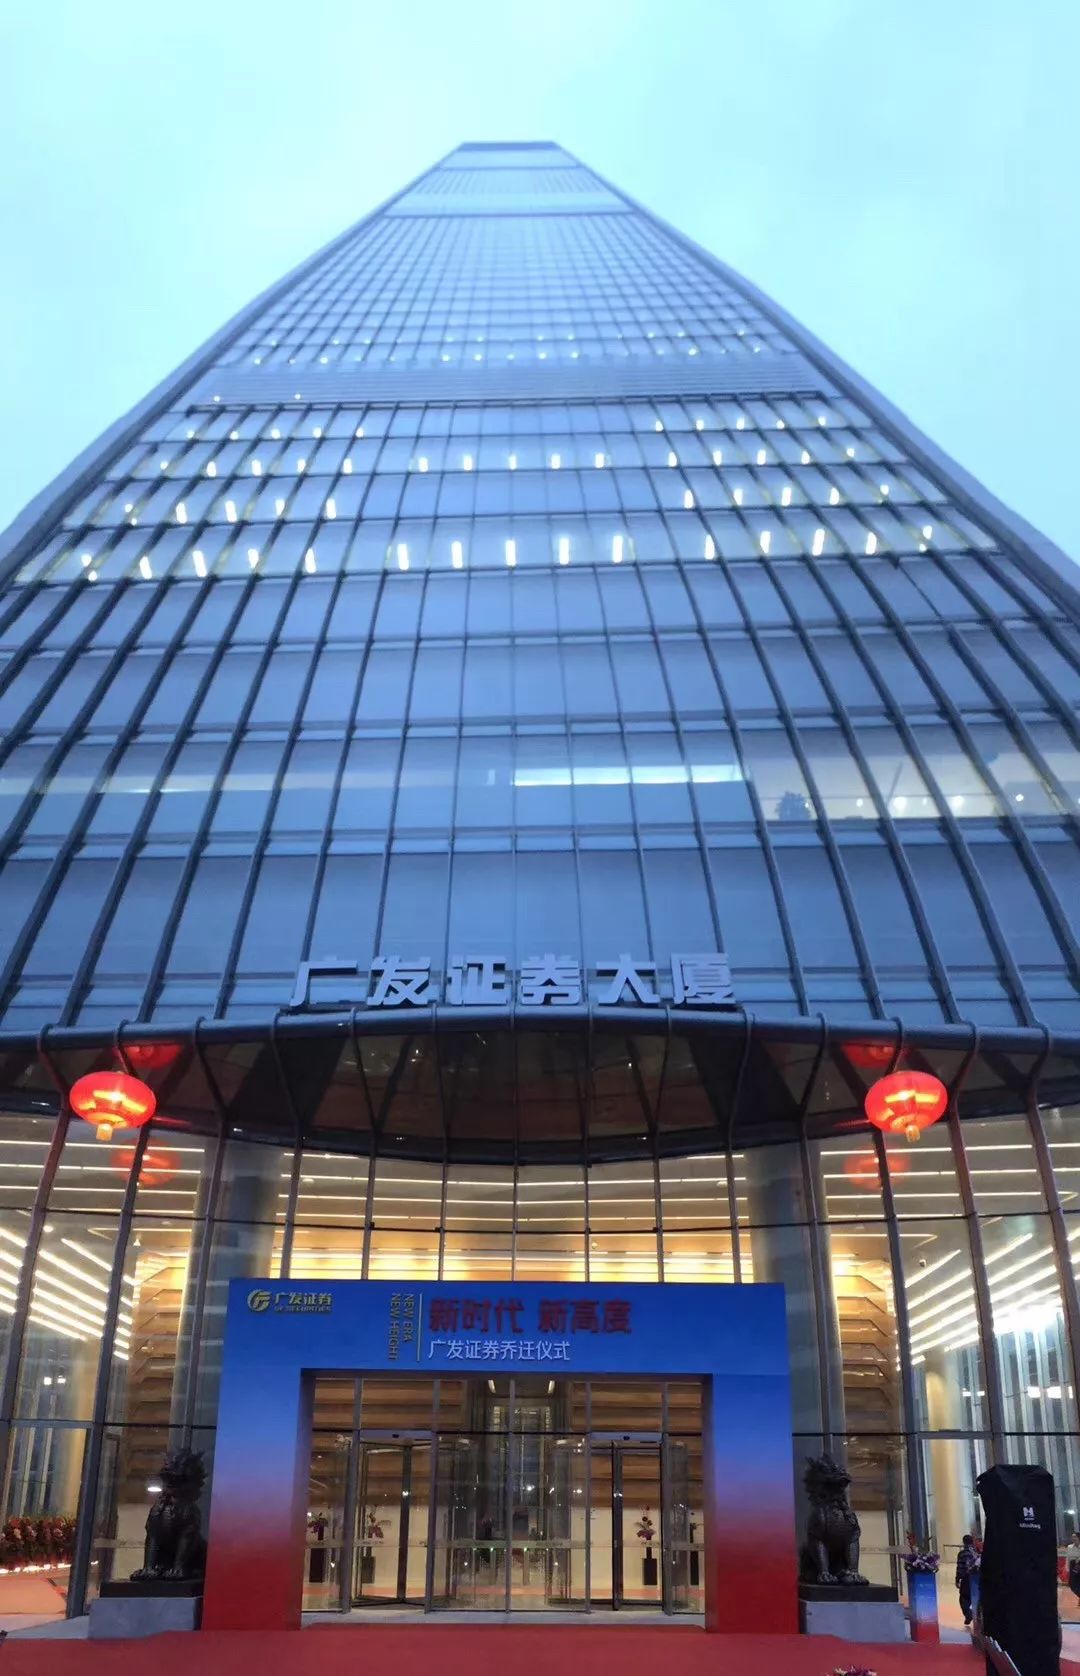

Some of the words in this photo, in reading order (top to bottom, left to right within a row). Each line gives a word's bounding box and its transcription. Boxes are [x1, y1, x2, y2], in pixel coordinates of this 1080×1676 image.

[290, 953, 737, 1006] 广发证券大厦
[274, 1292, 332, 1305] 广发证券
[391, 1293, 400, 1318] NEW
[403, 1294, 414, 1319] NEW
[429, 1298, 525, 1334] 新时代
[538, 1298, 632, 1334] 新高度
[389, 1320, 399, 1360] HEIGHT
[403, 1321, 412, 1341] ERA
[428, 1340, 570, 1361] 广发证券乔迁仪式
